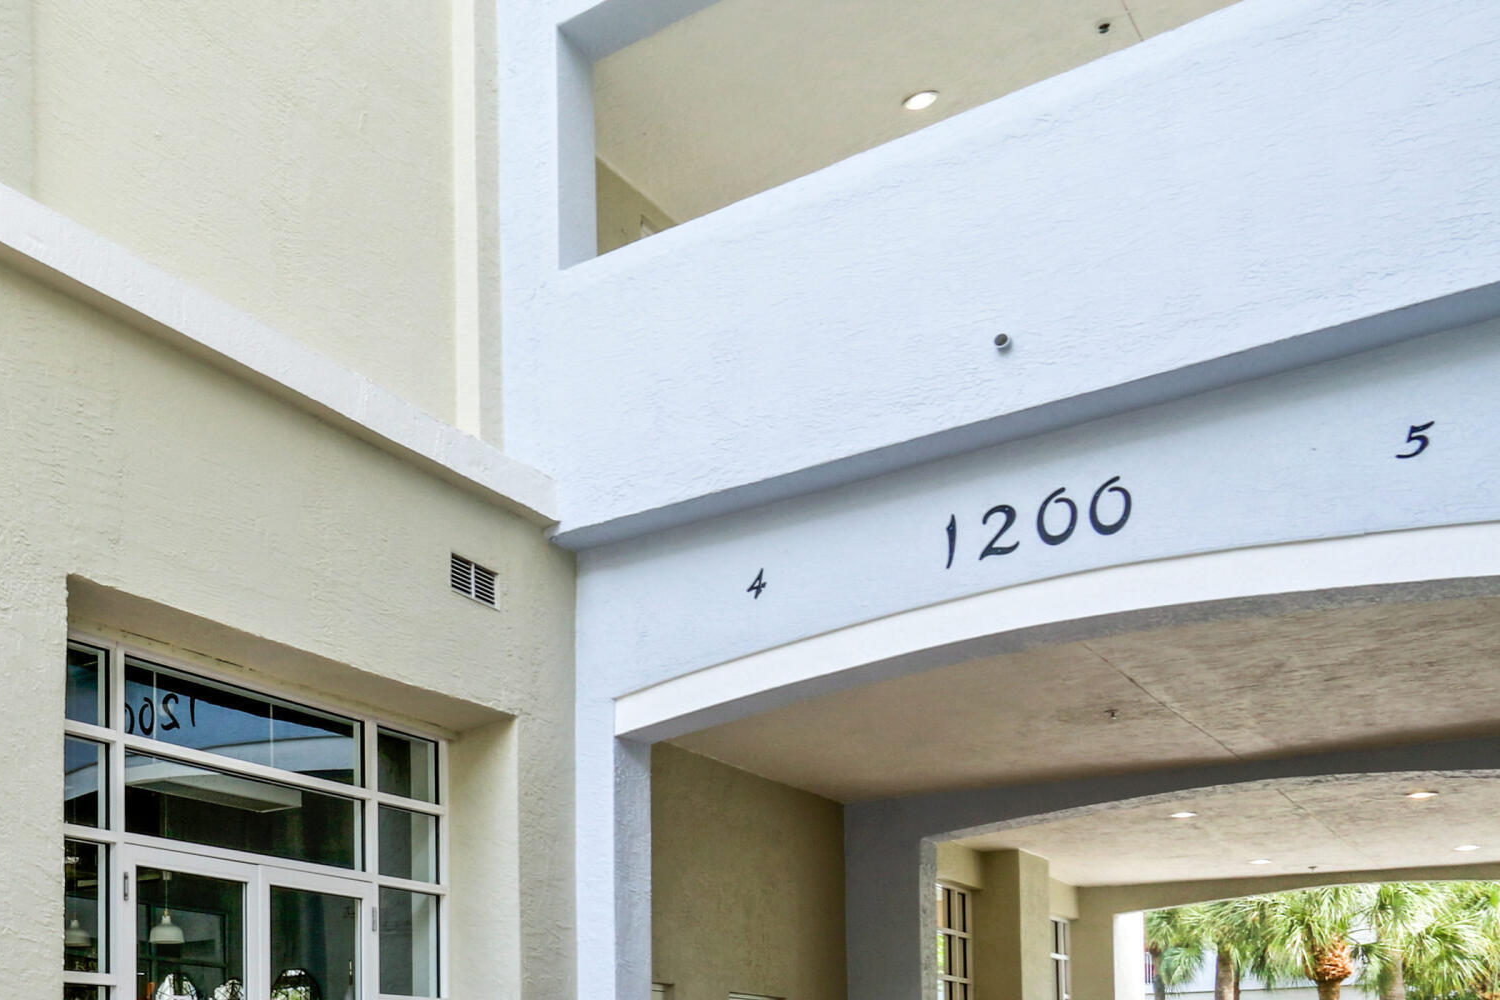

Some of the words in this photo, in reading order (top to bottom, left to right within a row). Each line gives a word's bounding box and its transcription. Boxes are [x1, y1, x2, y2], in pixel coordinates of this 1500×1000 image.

[1395, 420, 1435, 459] 5
[944, 475, 1133, 569] 1200
[746, 568, 767, 600] 4
